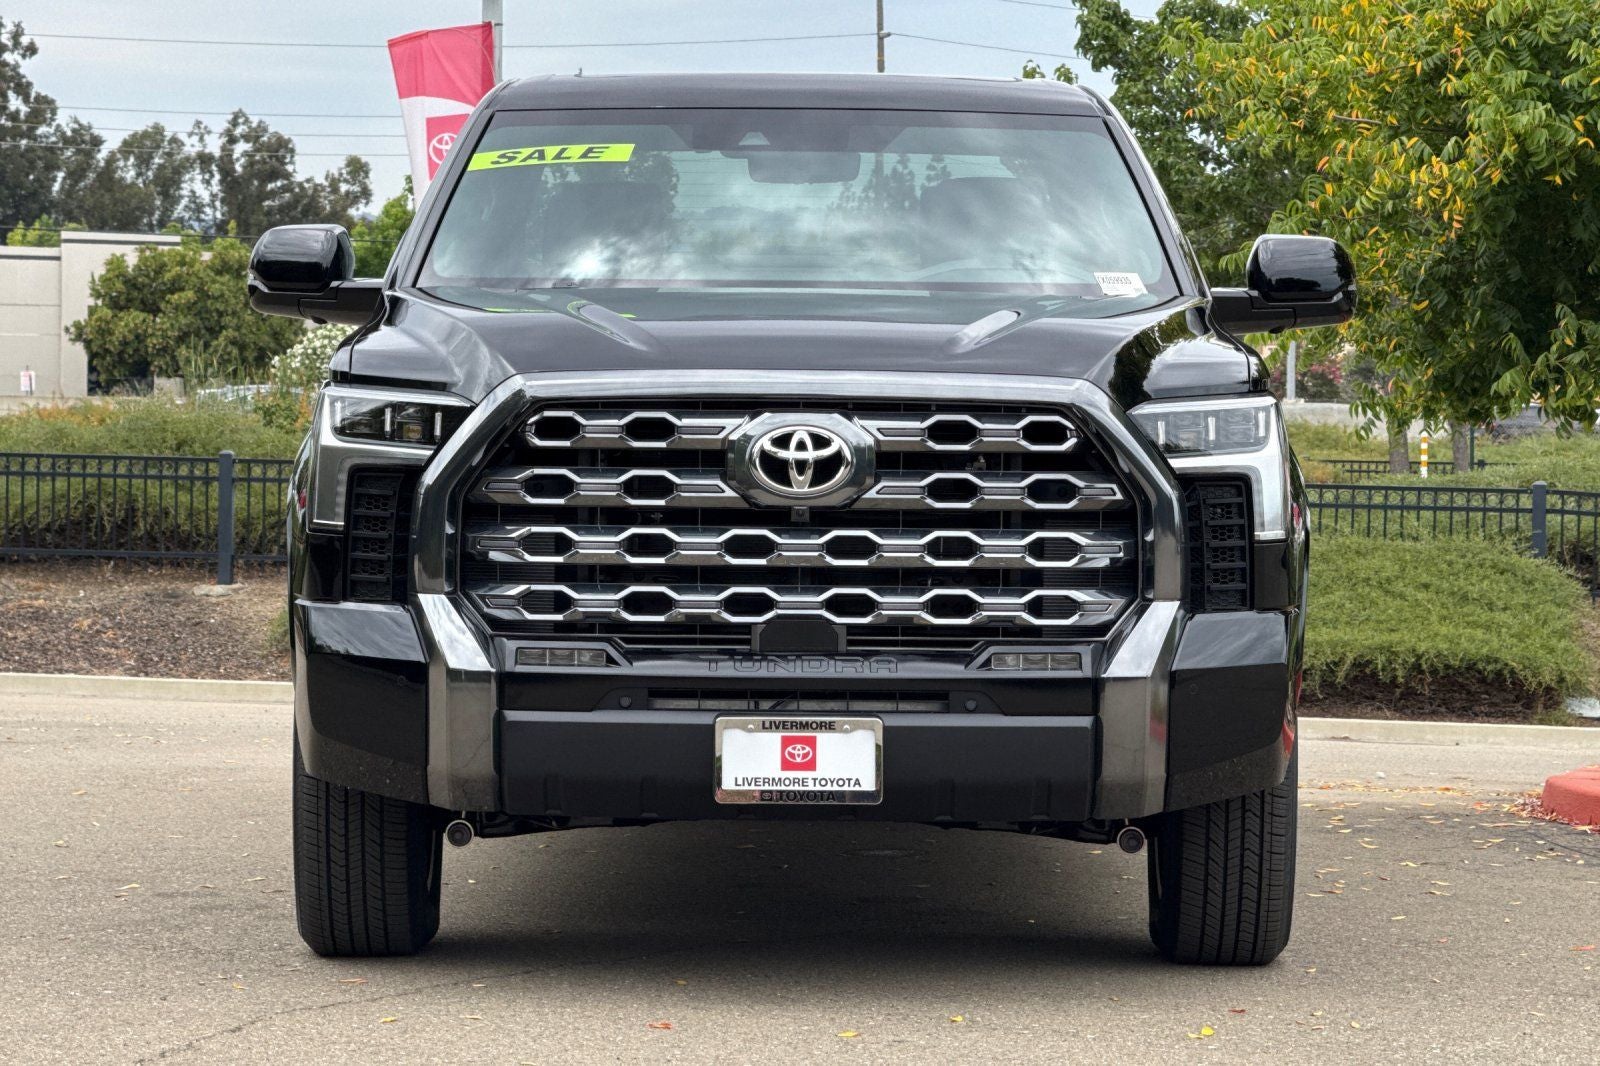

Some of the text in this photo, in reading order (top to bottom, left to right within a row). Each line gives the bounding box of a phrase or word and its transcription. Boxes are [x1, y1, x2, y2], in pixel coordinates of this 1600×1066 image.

[490, 145, 610, 165] SALE
[699, 655, 898, 673] TUNDRA
[761, 720, 836, 731] LIVERMORE
[734, 777, 862, 788] LIVERMORE TOYOTA
[777, 790, 837, 802] TOYOTA
